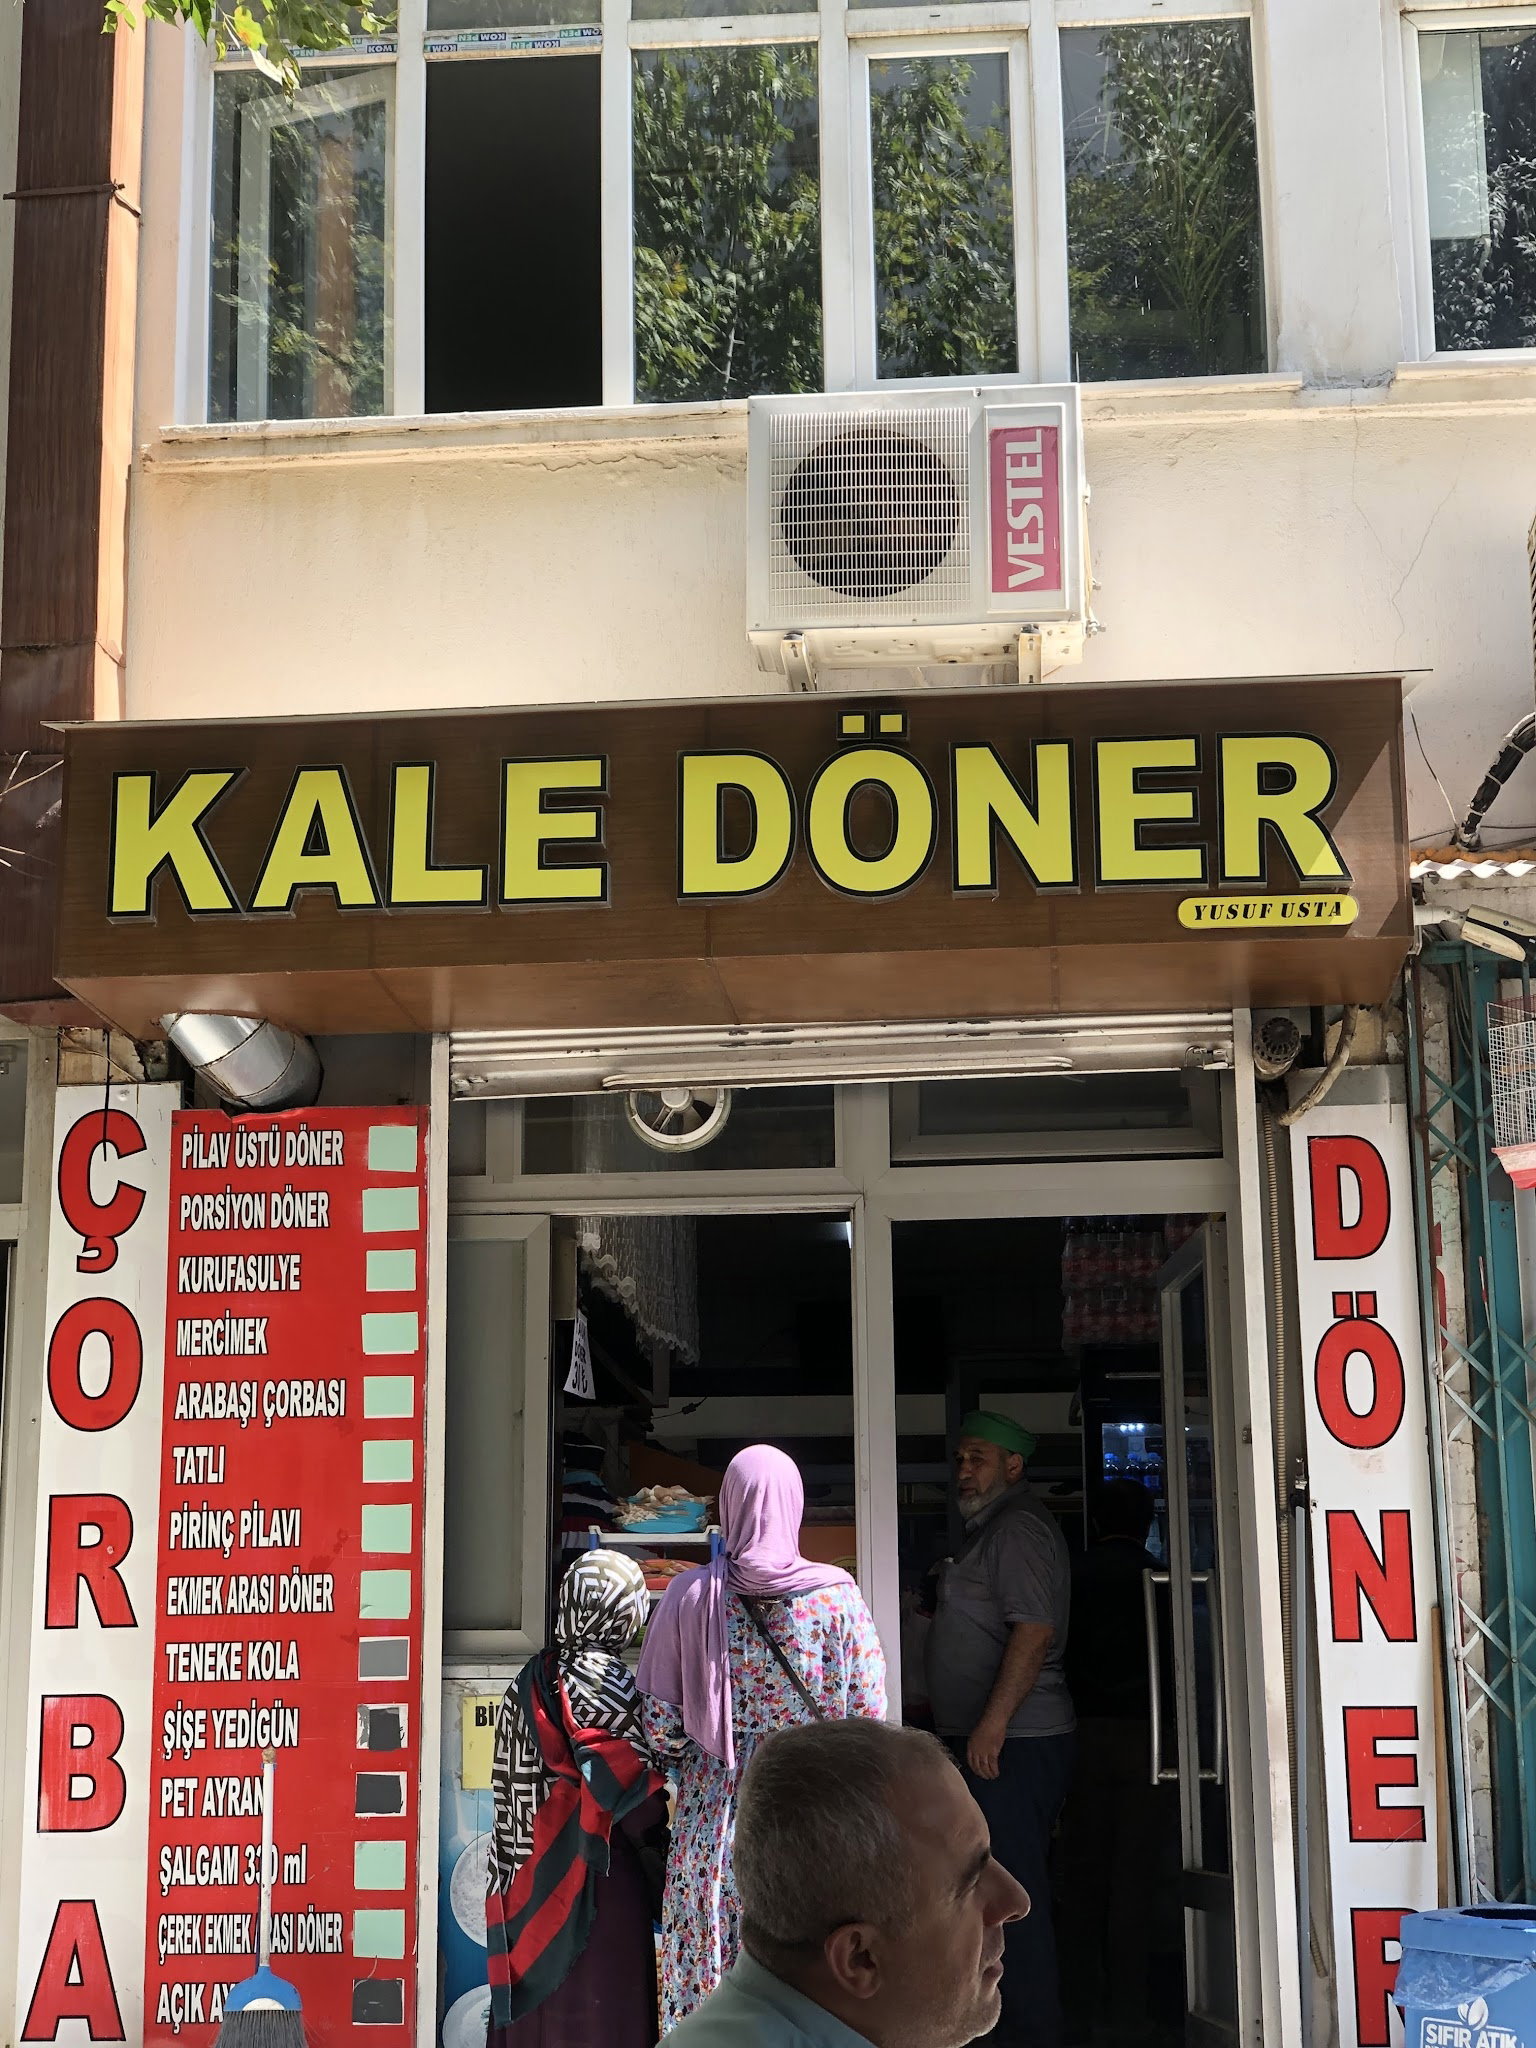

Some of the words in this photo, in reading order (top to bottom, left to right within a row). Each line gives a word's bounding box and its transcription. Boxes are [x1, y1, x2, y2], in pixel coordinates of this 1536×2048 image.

[1005, 430, 1046, 588] VESTEL
[108, 754, 609, 918] KALE
[677, 710, 1352, 900] DÖNER
[1194, 903, 1273, 921] YUSUF
[1281, 901, 1342, 918] USTA
[181, 1125, 230, 1169] PİLAV
[235, 1121, 281, 1168] ÜSTÜ
[284, 1120, 344, 1167] DÖNER
[180, 1185, 268, 1231] PORSİYON
[270, 1185, 330, 1229] DÖNER
[178, 1253, 302, 1294] KURUFASULYE
[176, 1309, 268, 1356] MERCİMEK
[174, 1380, 258, 1428] ARABAŞI
[262, 1379, 346, 1427] ÇORBASI
[172, 1445, 226, 1484] TATLI
[169, 1501, 235, 1558] PİRİNÇ
[239, 1500, 301, 1548] PİLAVI
[20, 1108, 148, 2042] ÇORBA
[166, 1574, 224, 1616] EKMEK
[226, 1573, 275, 1614] ARASI
[278, 1566, 334, 1613] DÖNER
[166, 1641, 242, 1683] TENEKE
[247, 1640, 300, 1681] KOLA
[163, 1700, 206, 1760] ŞİŞE
[212, 1698, 299, 1748] YEDİGÜN
[160, 1777, 199, 1818] PET
[159, 1845, 239, 1896] ŞALGAM
[283, 1843, 307, 1884] ml
[158, 1914, 202, 1965] ÇEREK
[204, 1913, 251, 1954] EKMEK
[296, 1904, 343, 1953] DÖNER
[156, 1982, 206, 2034] AÇIK
[1425, 2023, 1472, 2048] SIFIR
[1476, 2030, 1517, 2048] ATIK
